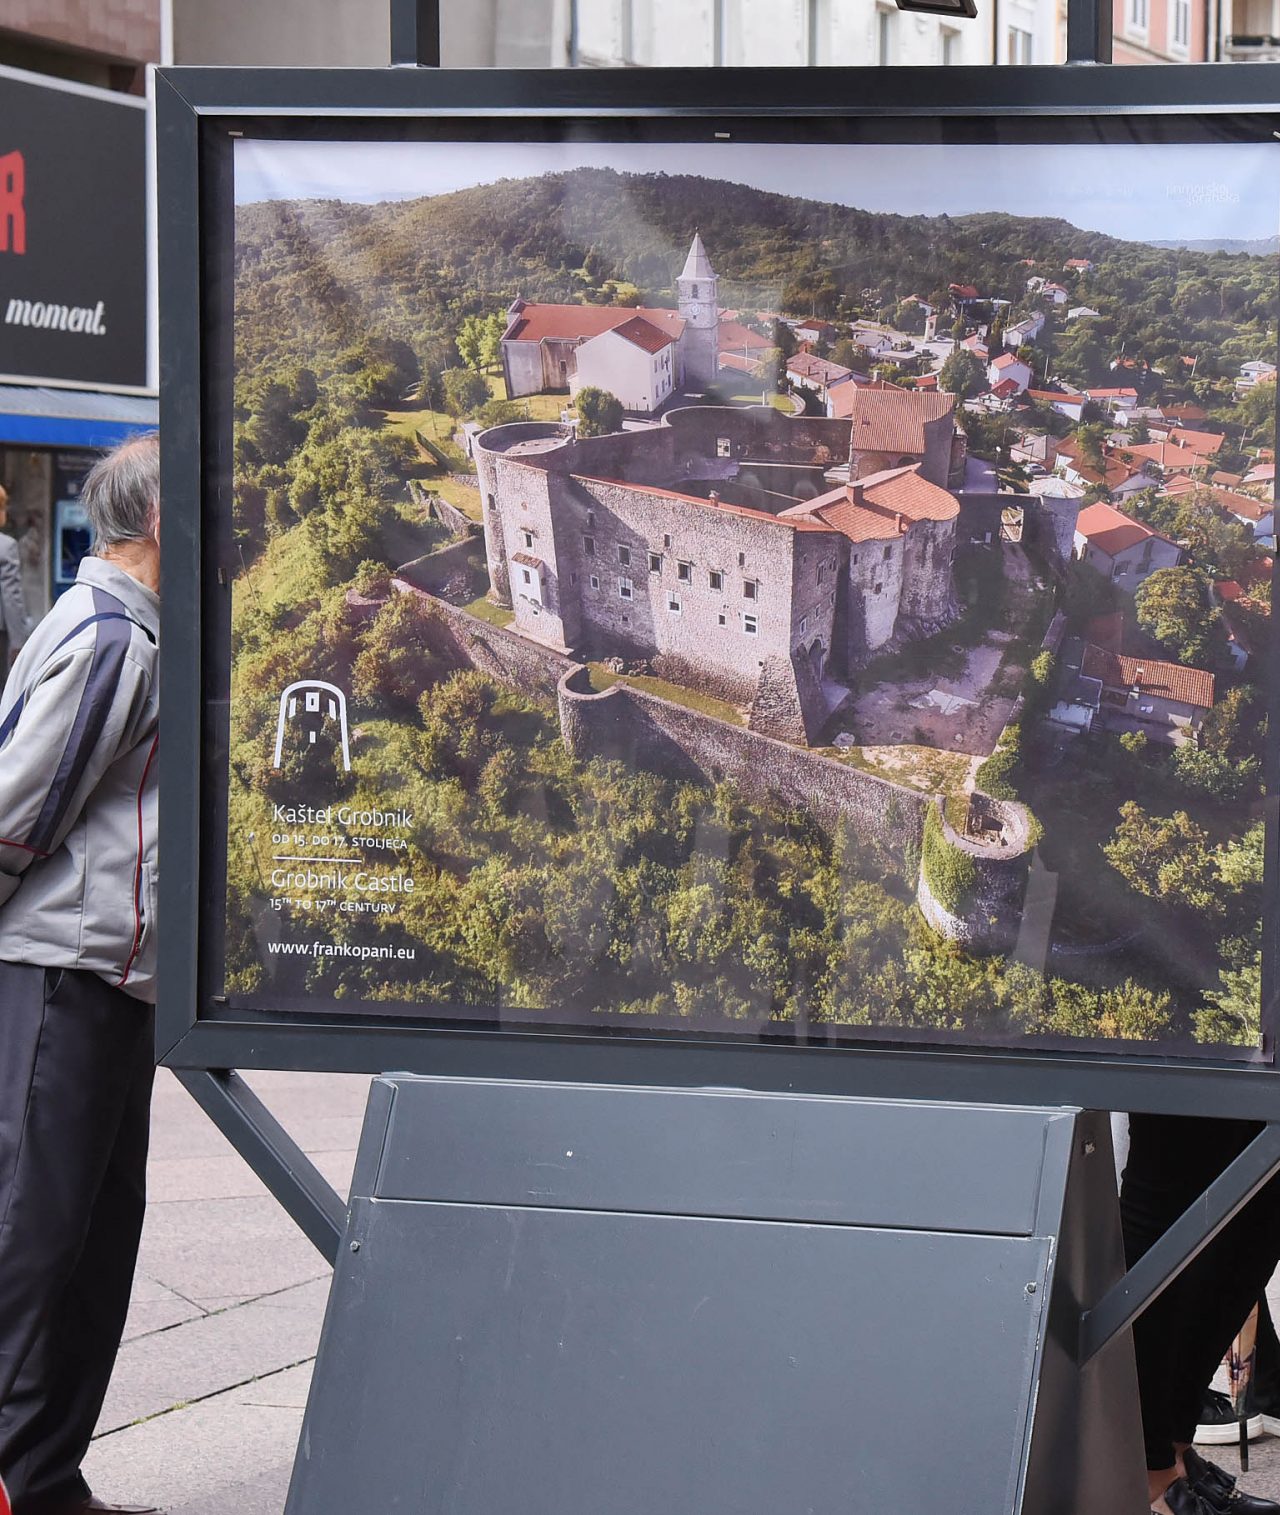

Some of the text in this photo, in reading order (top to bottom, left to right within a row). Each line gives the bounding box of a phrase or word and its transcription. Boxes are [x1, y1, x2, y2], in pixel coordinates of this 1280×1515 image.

[4, 298, 106, 335] moment.
[273, 803, 413, 828] Kaštel Grobnik
[272, 833, 290, 844] OD
[294, 834, 308, 847] 15.
[312, 835, 330, 846] DO
[334, 836, 348, 849] 17.
[271, 869, 414, 893] Grobnik Castle
[295, 900, 312, 910] TO
[339, 900, 396, 914] CENTURY
[267, 941, 415, 961] www.frankopani.eu
